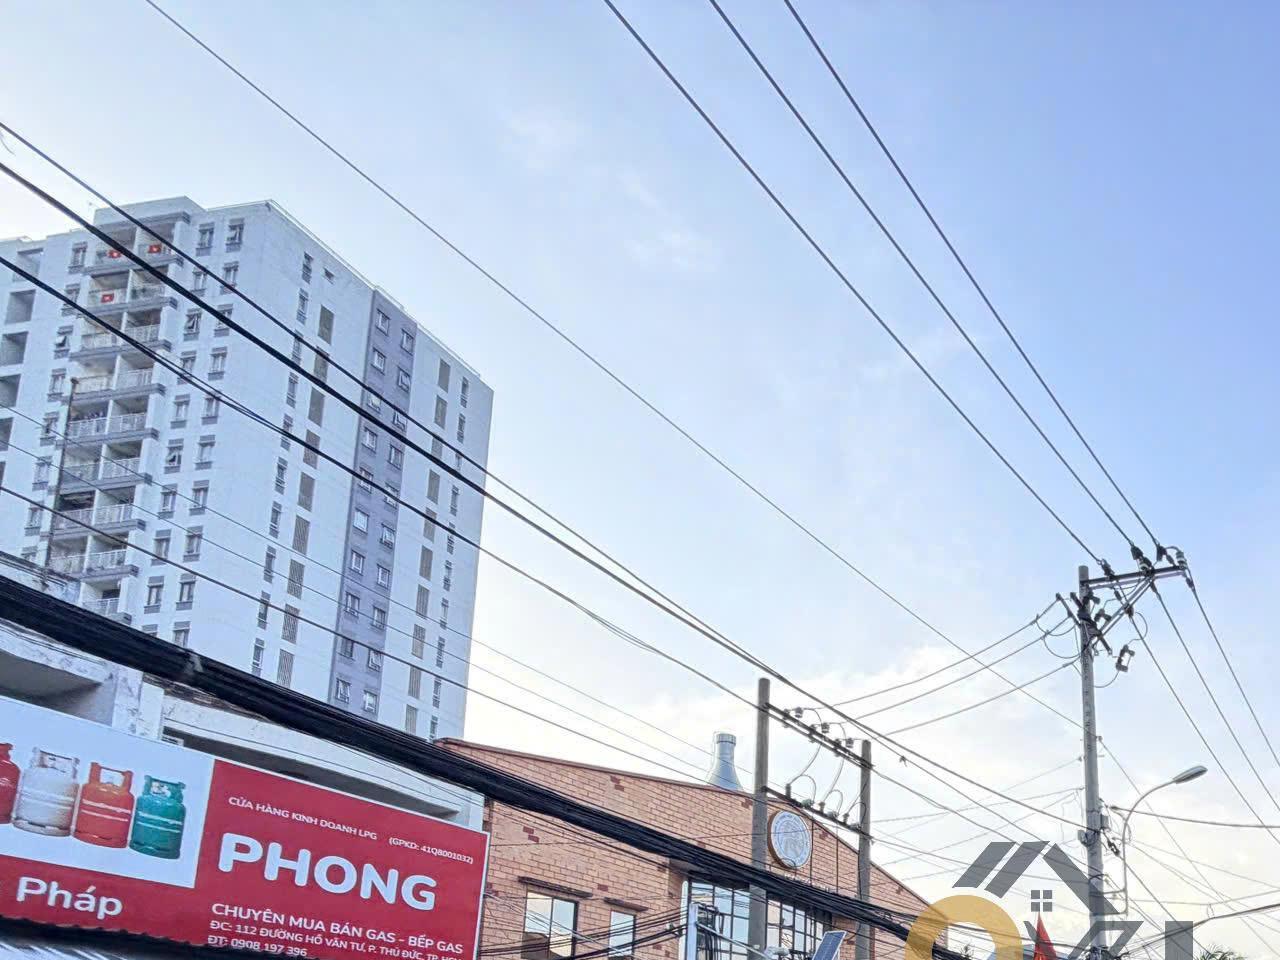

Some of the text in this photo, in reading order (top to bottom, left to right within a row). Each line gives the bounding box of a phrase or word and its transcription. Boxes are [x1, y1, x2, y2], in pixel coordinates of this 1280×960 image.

[228, 796, 254, 811] CỬA
[255, 803, 290, 818] HÀNG
[291, 812, 318, 826] KINH
[319, 819, 357, 836] DOANH
[358, 829, 378, 841] LPG
[217, 832, 438, 911] PHONG
[16, 876, 123, 920] Pháp
[211, 903, 285, 926] CHUYÊN
[289, 916, 326, 932] MUA
[330, 922, 363, 938] BÁN
[365, 929, 396, 943] GAS
[408, 934, 434, 949] BẾP
[436, 941, 464, 954] GAS
[230, 938, 261, 952] 0908
[264, 942, 285, 955] 197
[286, 946, 308, 957] 396
[235, 924, 257, 936] 112
[259, 927, 304, 943] ĐƯỜNG
[305, 933, 323, 945] HỒ
[324, 937, 348, 950] VĂN
[368, 944, 377, 954] P.
[379, 946, 400, 957] THỦ
